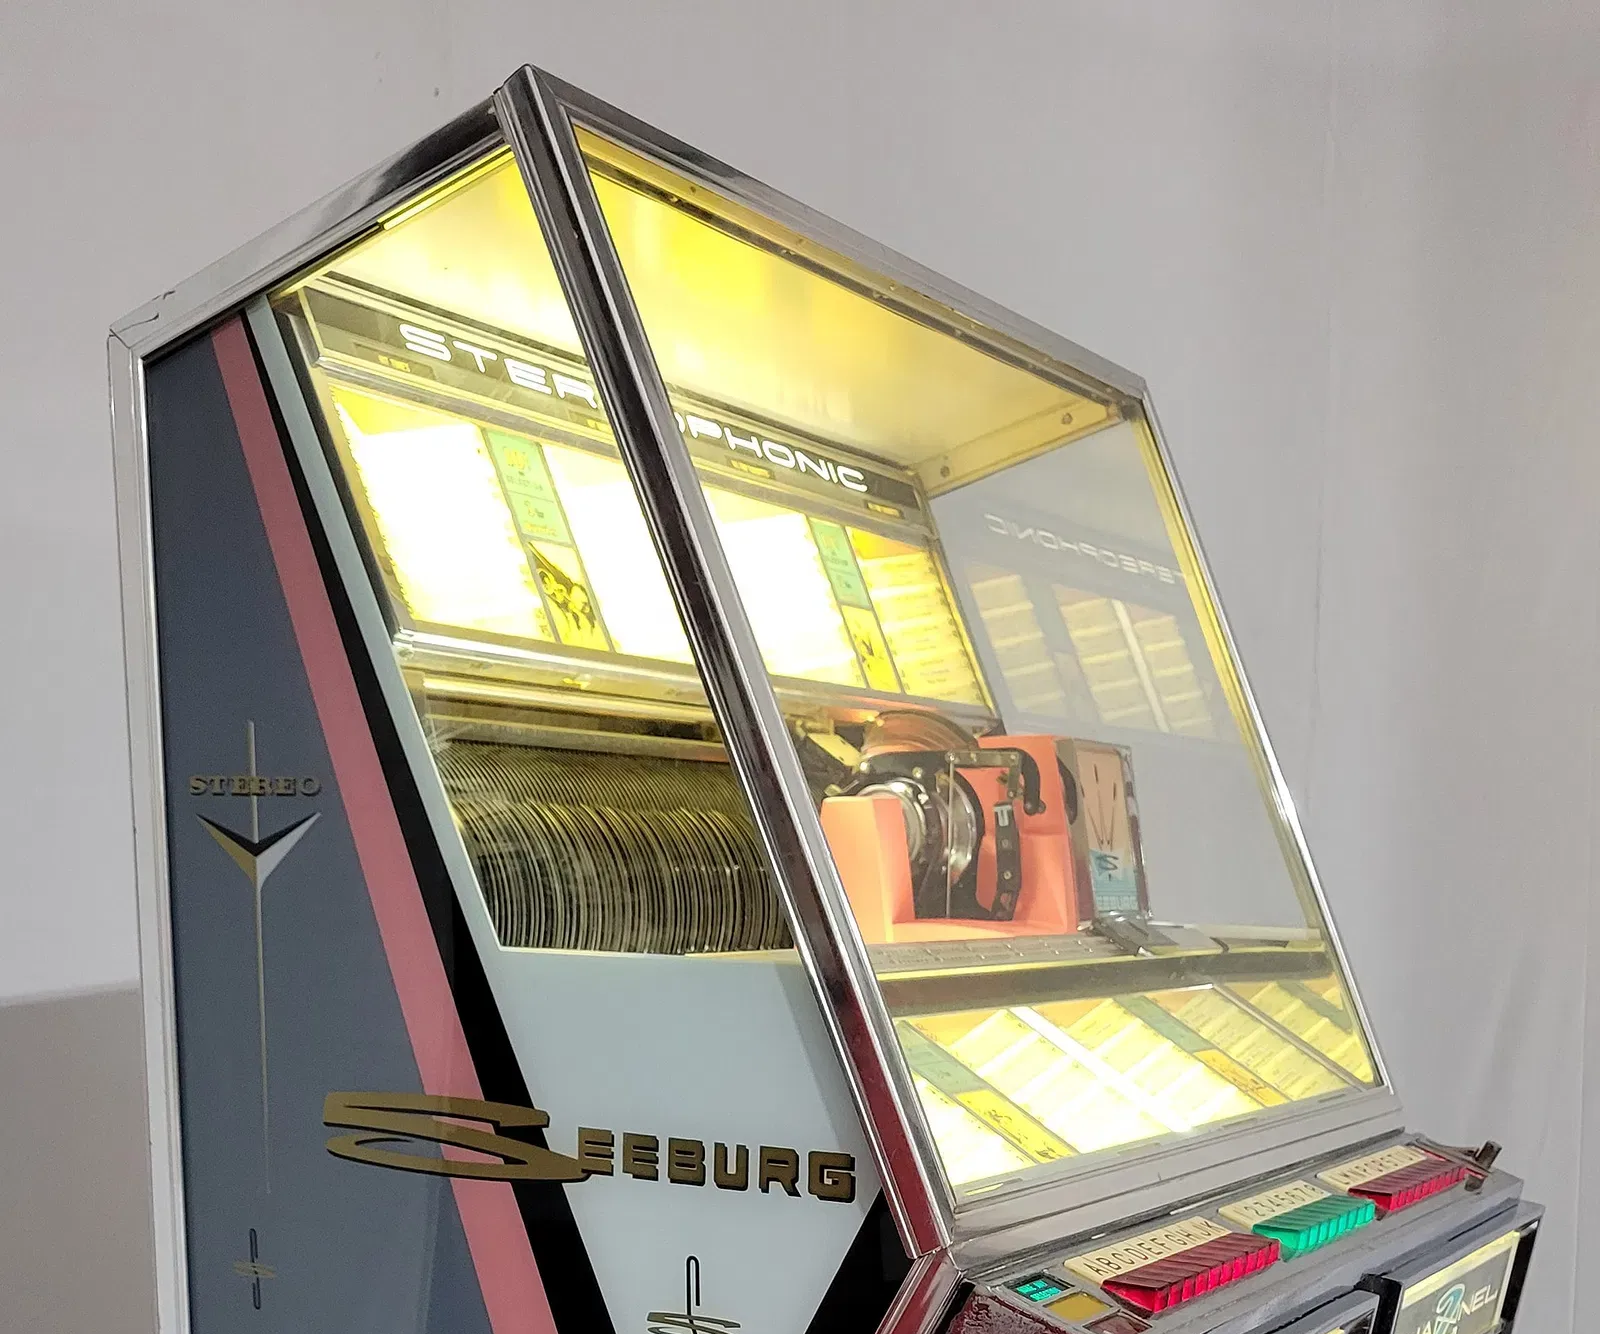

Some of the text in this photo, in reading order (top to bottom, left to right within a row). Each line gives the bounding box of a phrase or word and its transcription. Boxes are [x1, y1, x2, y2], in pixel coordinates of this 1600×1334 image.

[398, 323, 868, 493] STERPHONIC
[189, 775, 322, 796] STEREO
[323, 1092, 856, 1204] SEEBURG
